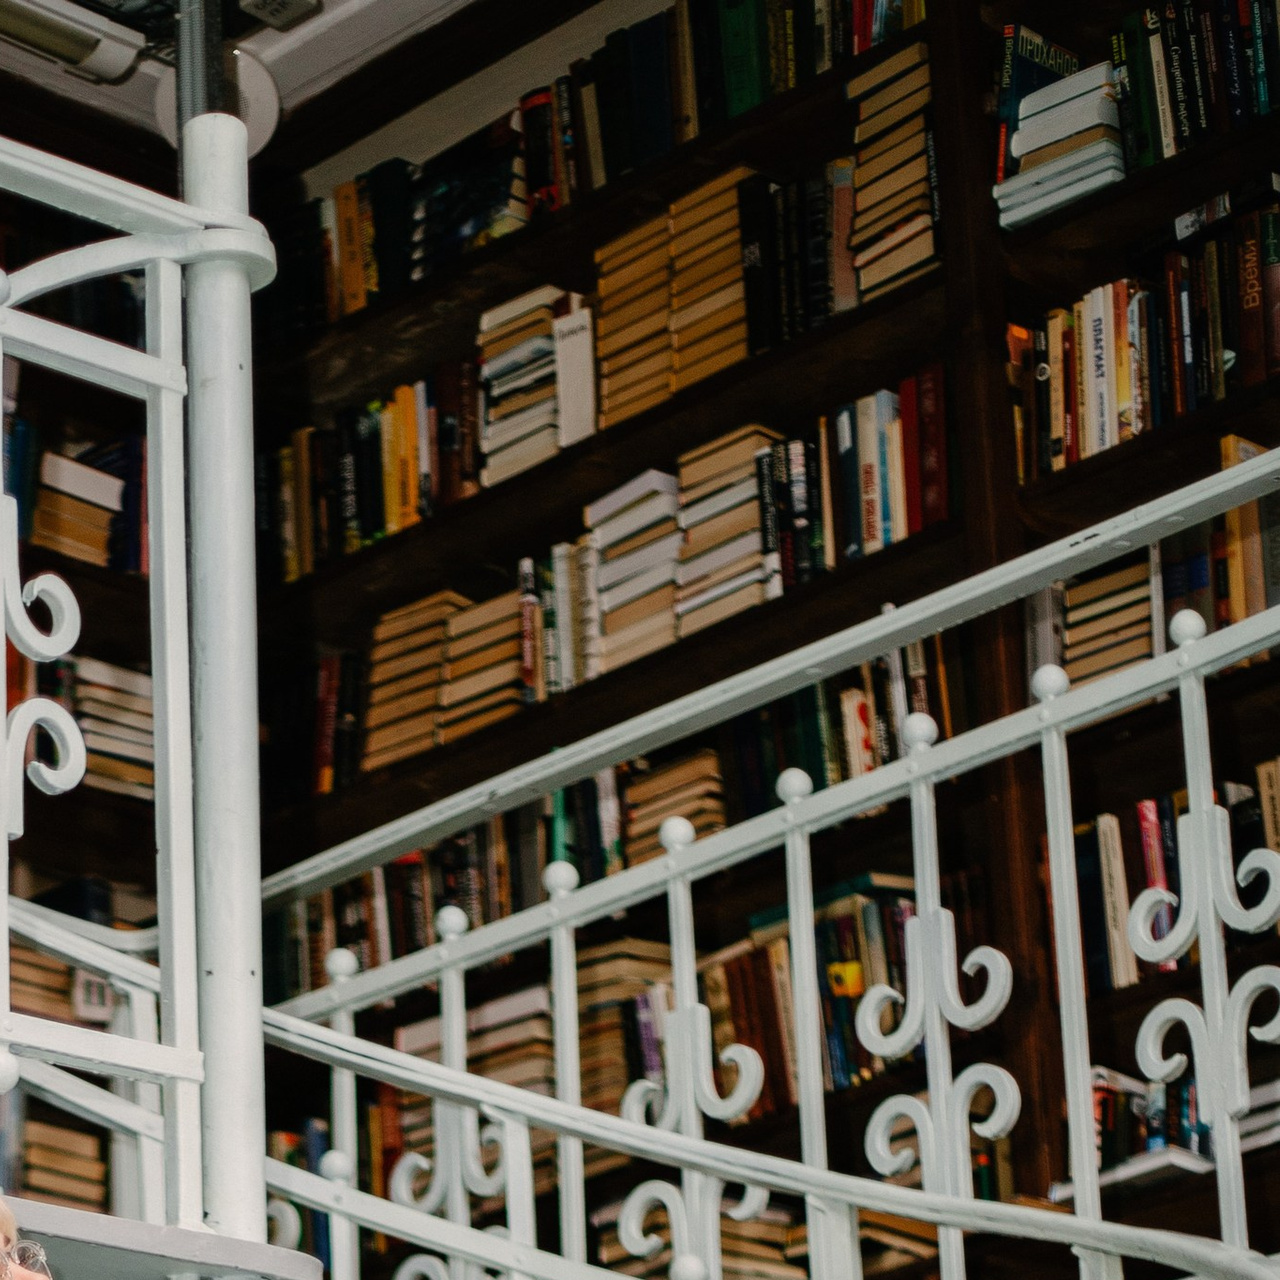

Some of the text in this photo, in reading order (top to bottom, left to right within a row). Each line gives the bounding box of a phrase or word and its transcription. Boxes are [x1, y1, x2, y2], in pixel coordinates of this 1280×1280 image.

[1002, 38, 1013, 88] ПРОХАНОВ
[1018, 34, 1079, 77] ПРОХАНОВ
[1243, 240, 1261, 310] Время
[1092, 318, 1105, 379] ПЛАГИАТ
